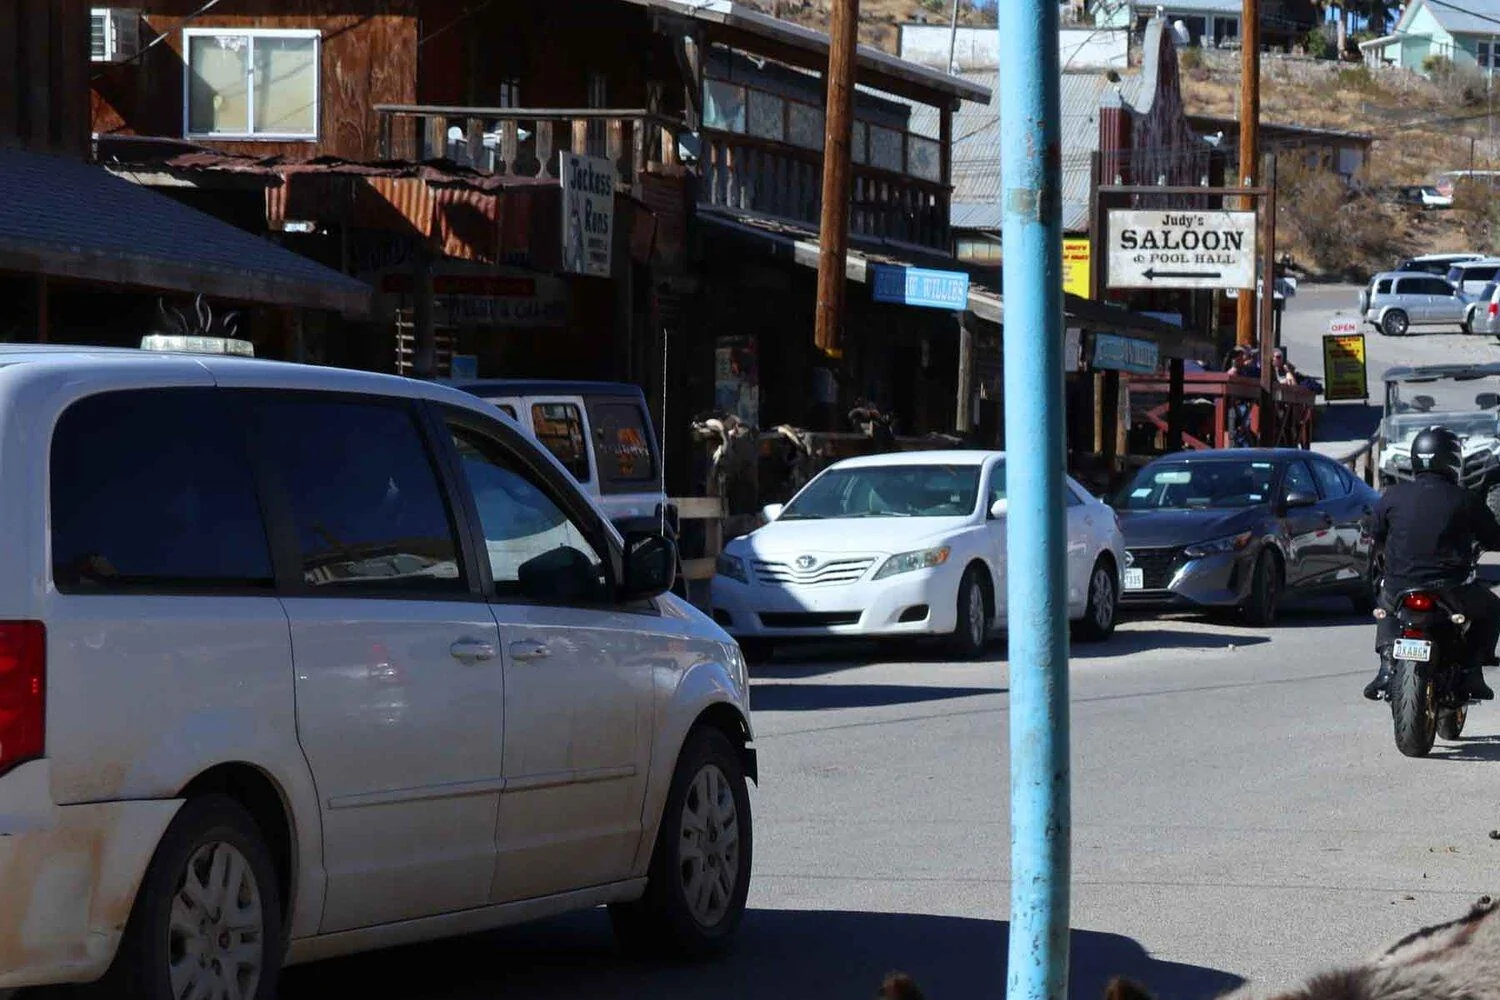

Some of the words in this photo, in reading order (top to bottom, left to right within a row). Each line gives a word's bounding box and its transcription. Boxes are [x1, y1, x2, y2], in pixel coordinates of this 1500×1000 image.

[1162, 214, 1204, 228] Judy's
[1120, 229, 1244, 251] SALOON
[1150, 253, 1189, 264] POOL
[1194, 254, 1236, 265] HALL
[1331, 324, 1355, 332] OPEN
